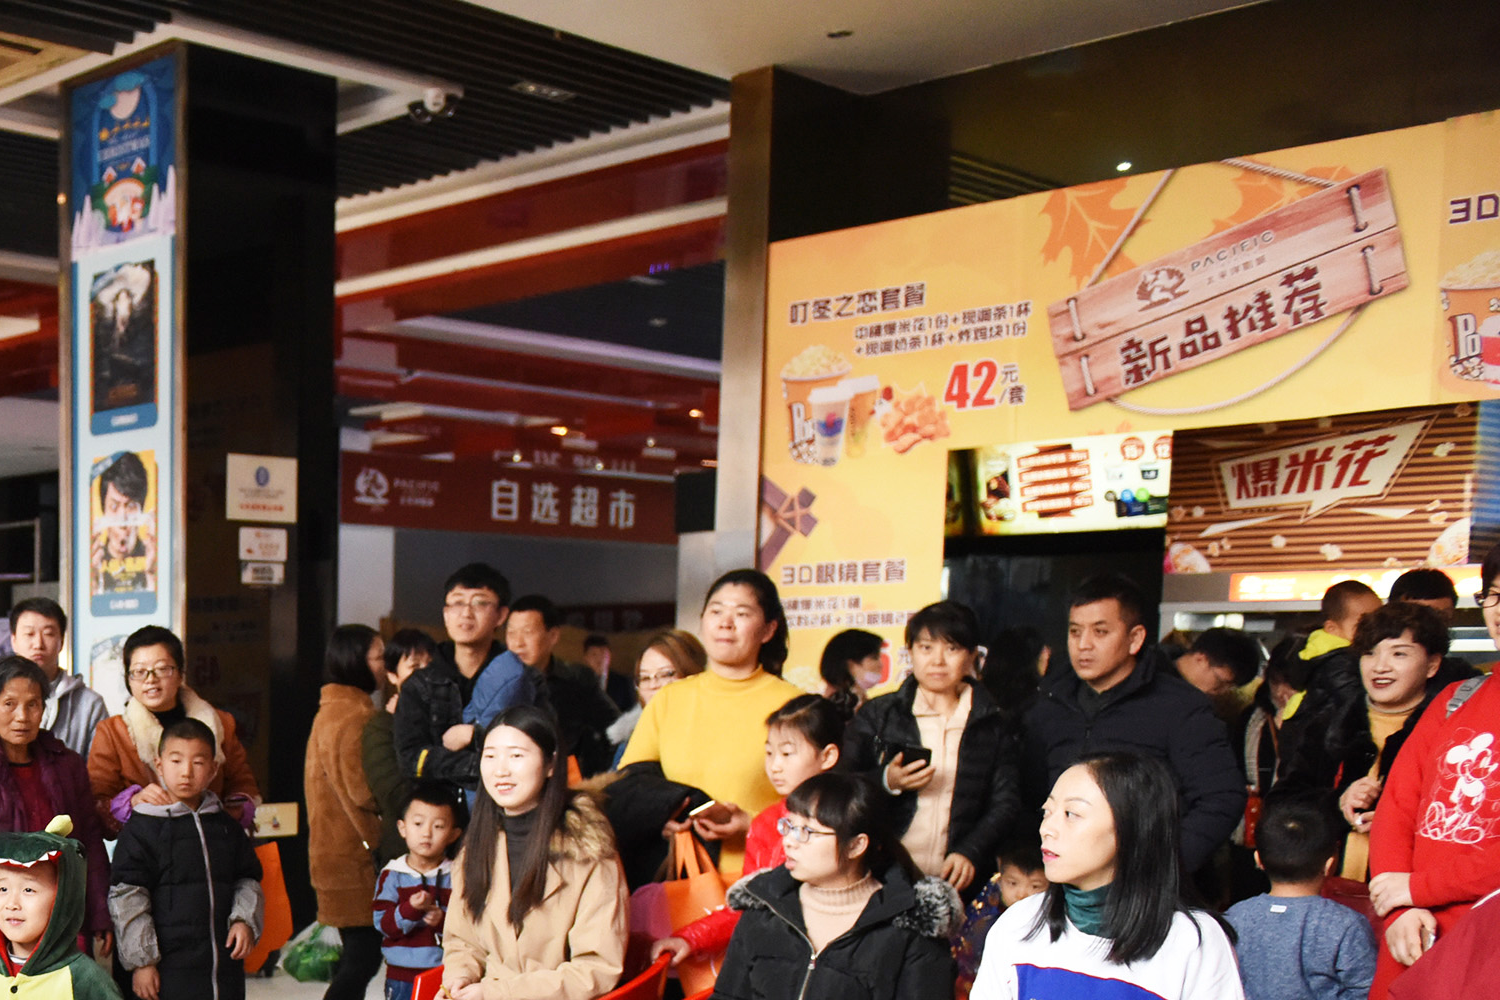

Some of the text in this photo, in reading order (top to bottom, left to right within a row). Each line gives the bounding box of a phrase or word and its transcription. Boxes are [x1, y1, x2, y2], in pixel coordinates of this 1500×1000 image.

[1190, 231, 1275, 272] PACIFIC
[1120, 264, 1329, 386] 新品推荐
[945, 361, 998, 409] 42
[1230, 435, 1398, 500] 爆米花
[491, 479, 636, 530] 自选超市
